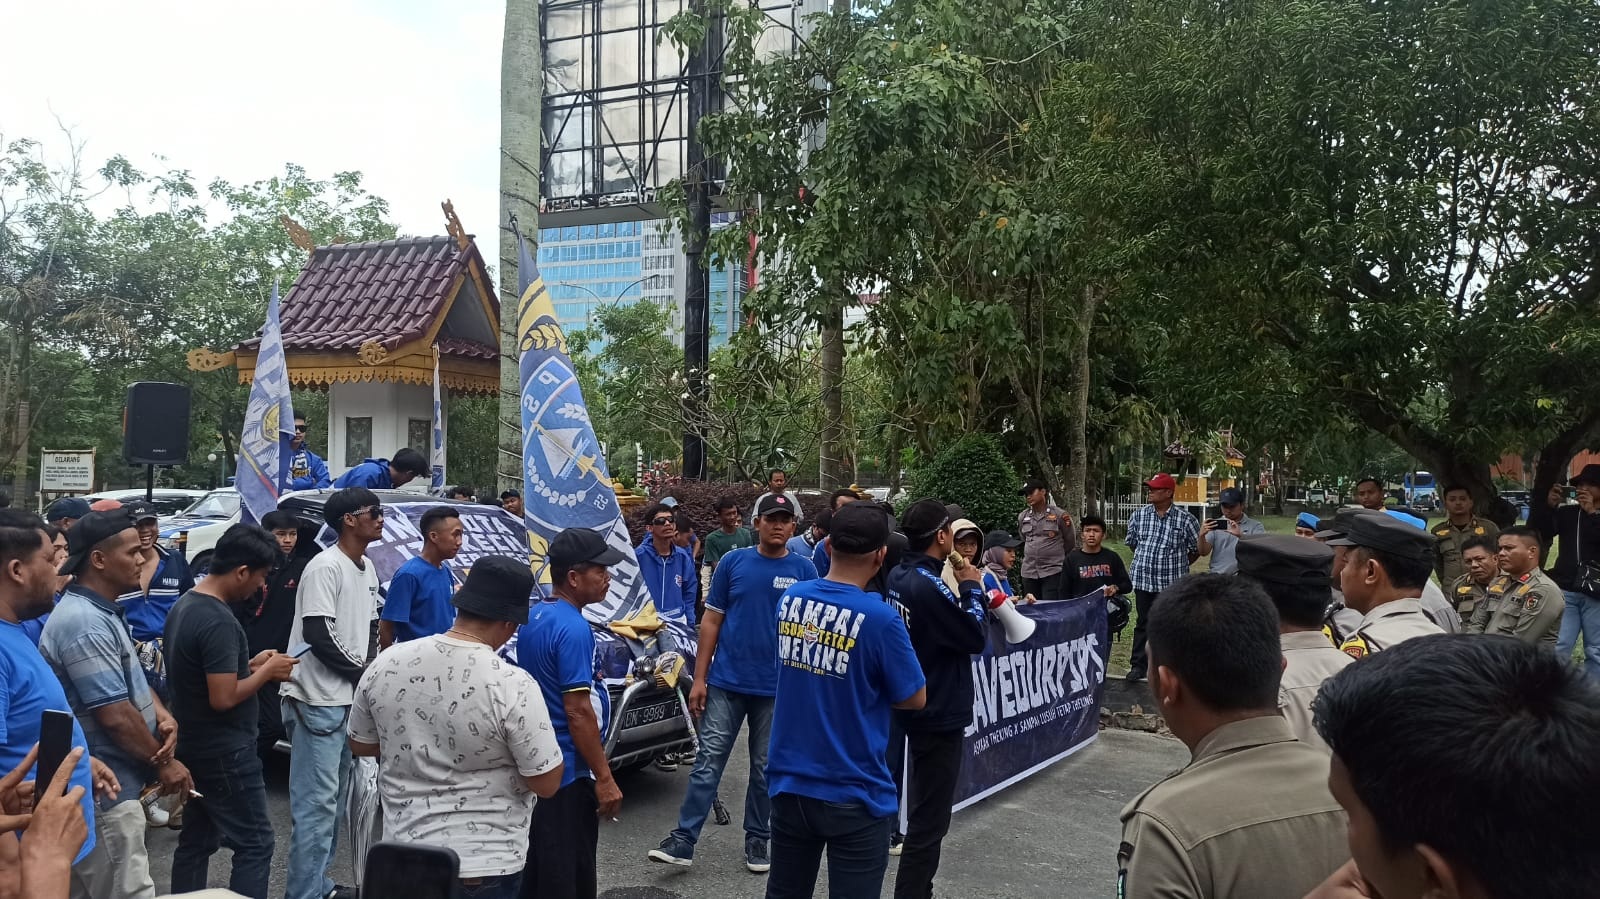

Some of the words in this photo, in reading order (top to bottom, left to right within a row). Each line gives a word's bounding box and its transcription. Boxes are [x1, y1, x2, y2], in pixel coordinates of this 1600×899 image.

[778, 595, 866, 639] SAMPAI
[818, 629, 856, 652] TETAP
[1056, 702, 1072, 717] TETAP
